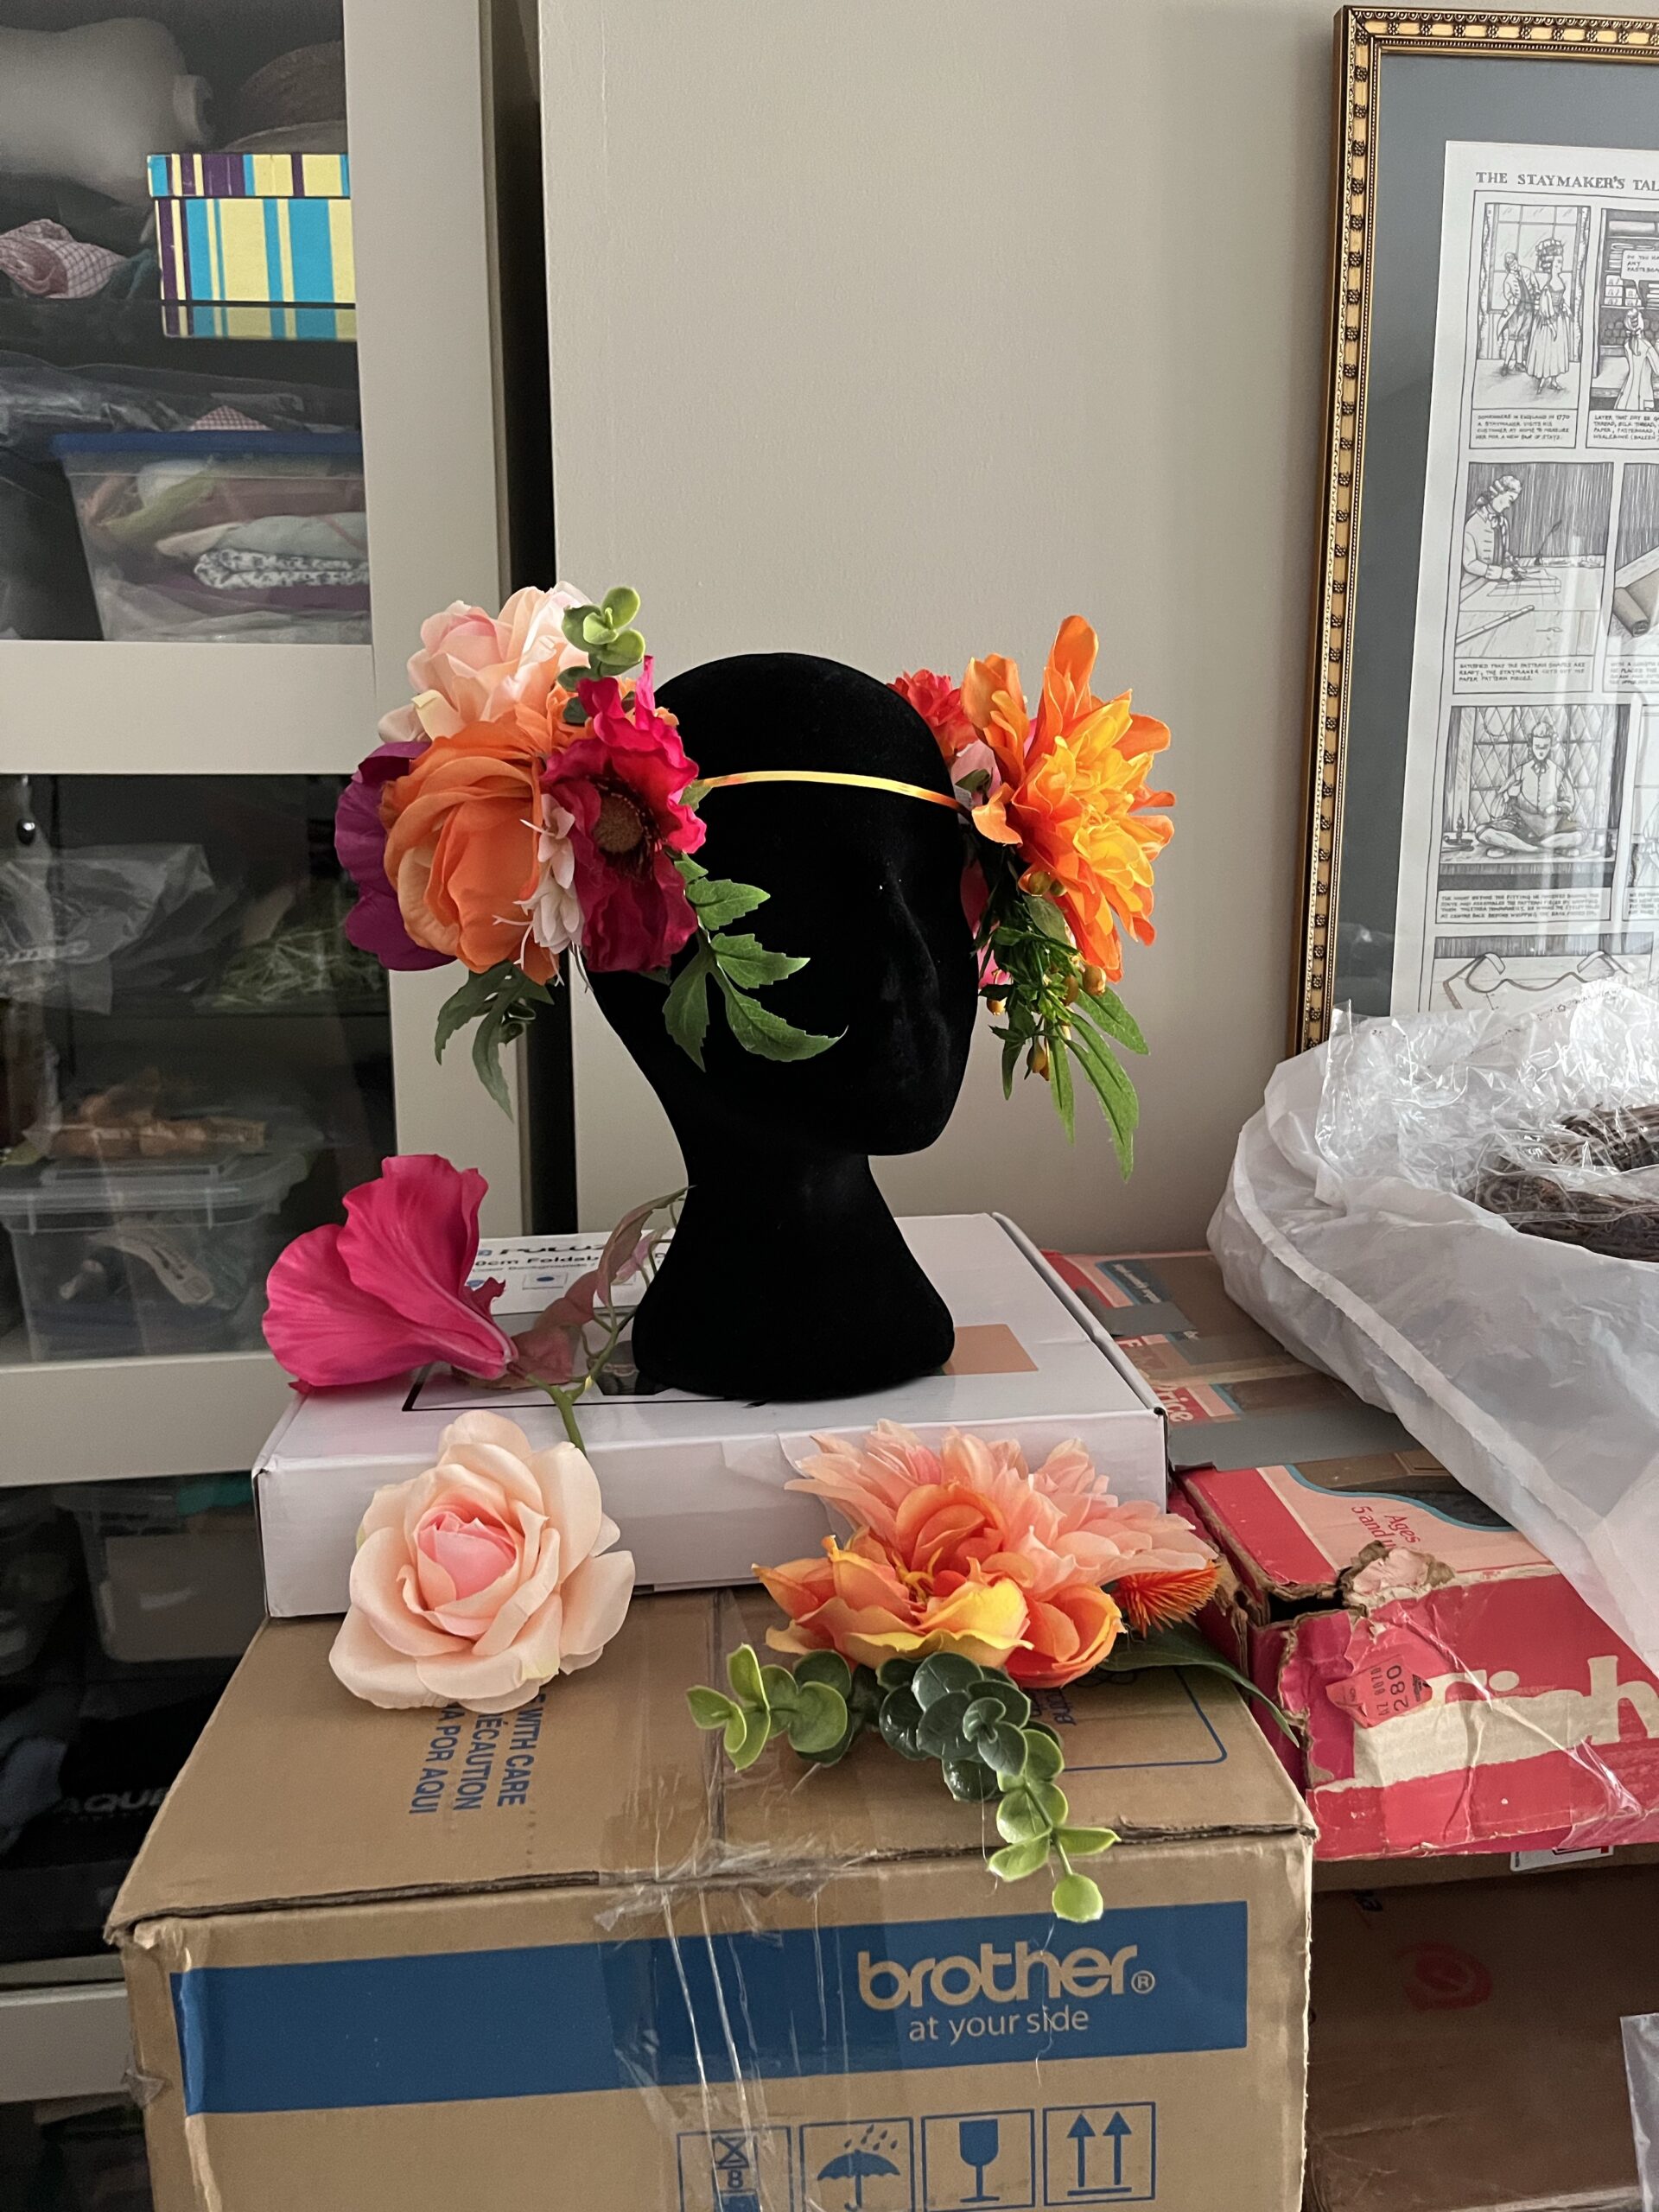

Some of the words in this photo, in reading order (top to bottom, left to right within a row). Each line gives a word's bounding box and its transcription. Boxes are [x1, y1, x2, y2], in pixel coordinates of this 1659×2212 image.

[1476, 171, 1508, 185] THE
[1517, 174, 1625, 189] STAYMAKER'S
[1358, 1516, 1395, 1538] and
[1383, 1515, 1421, 1543] Ages
[1386, 1664, 1409, 1712] 280
[425, 1725, 461, 1762] POR
[509, 1707, 544, 1751] WITH
[453, 1713, 509, 1811] ÉCAUTION
[497, 1754, 535, 1807] CARE
[409, 1768, 448, 1814] AQUI
[857, 1940, 1138, 2011] brother
[908, 2016, 939, 2042] at
[948, 2013, 1020, 2047] your
[1026, 2004, 1090, 2034] side
